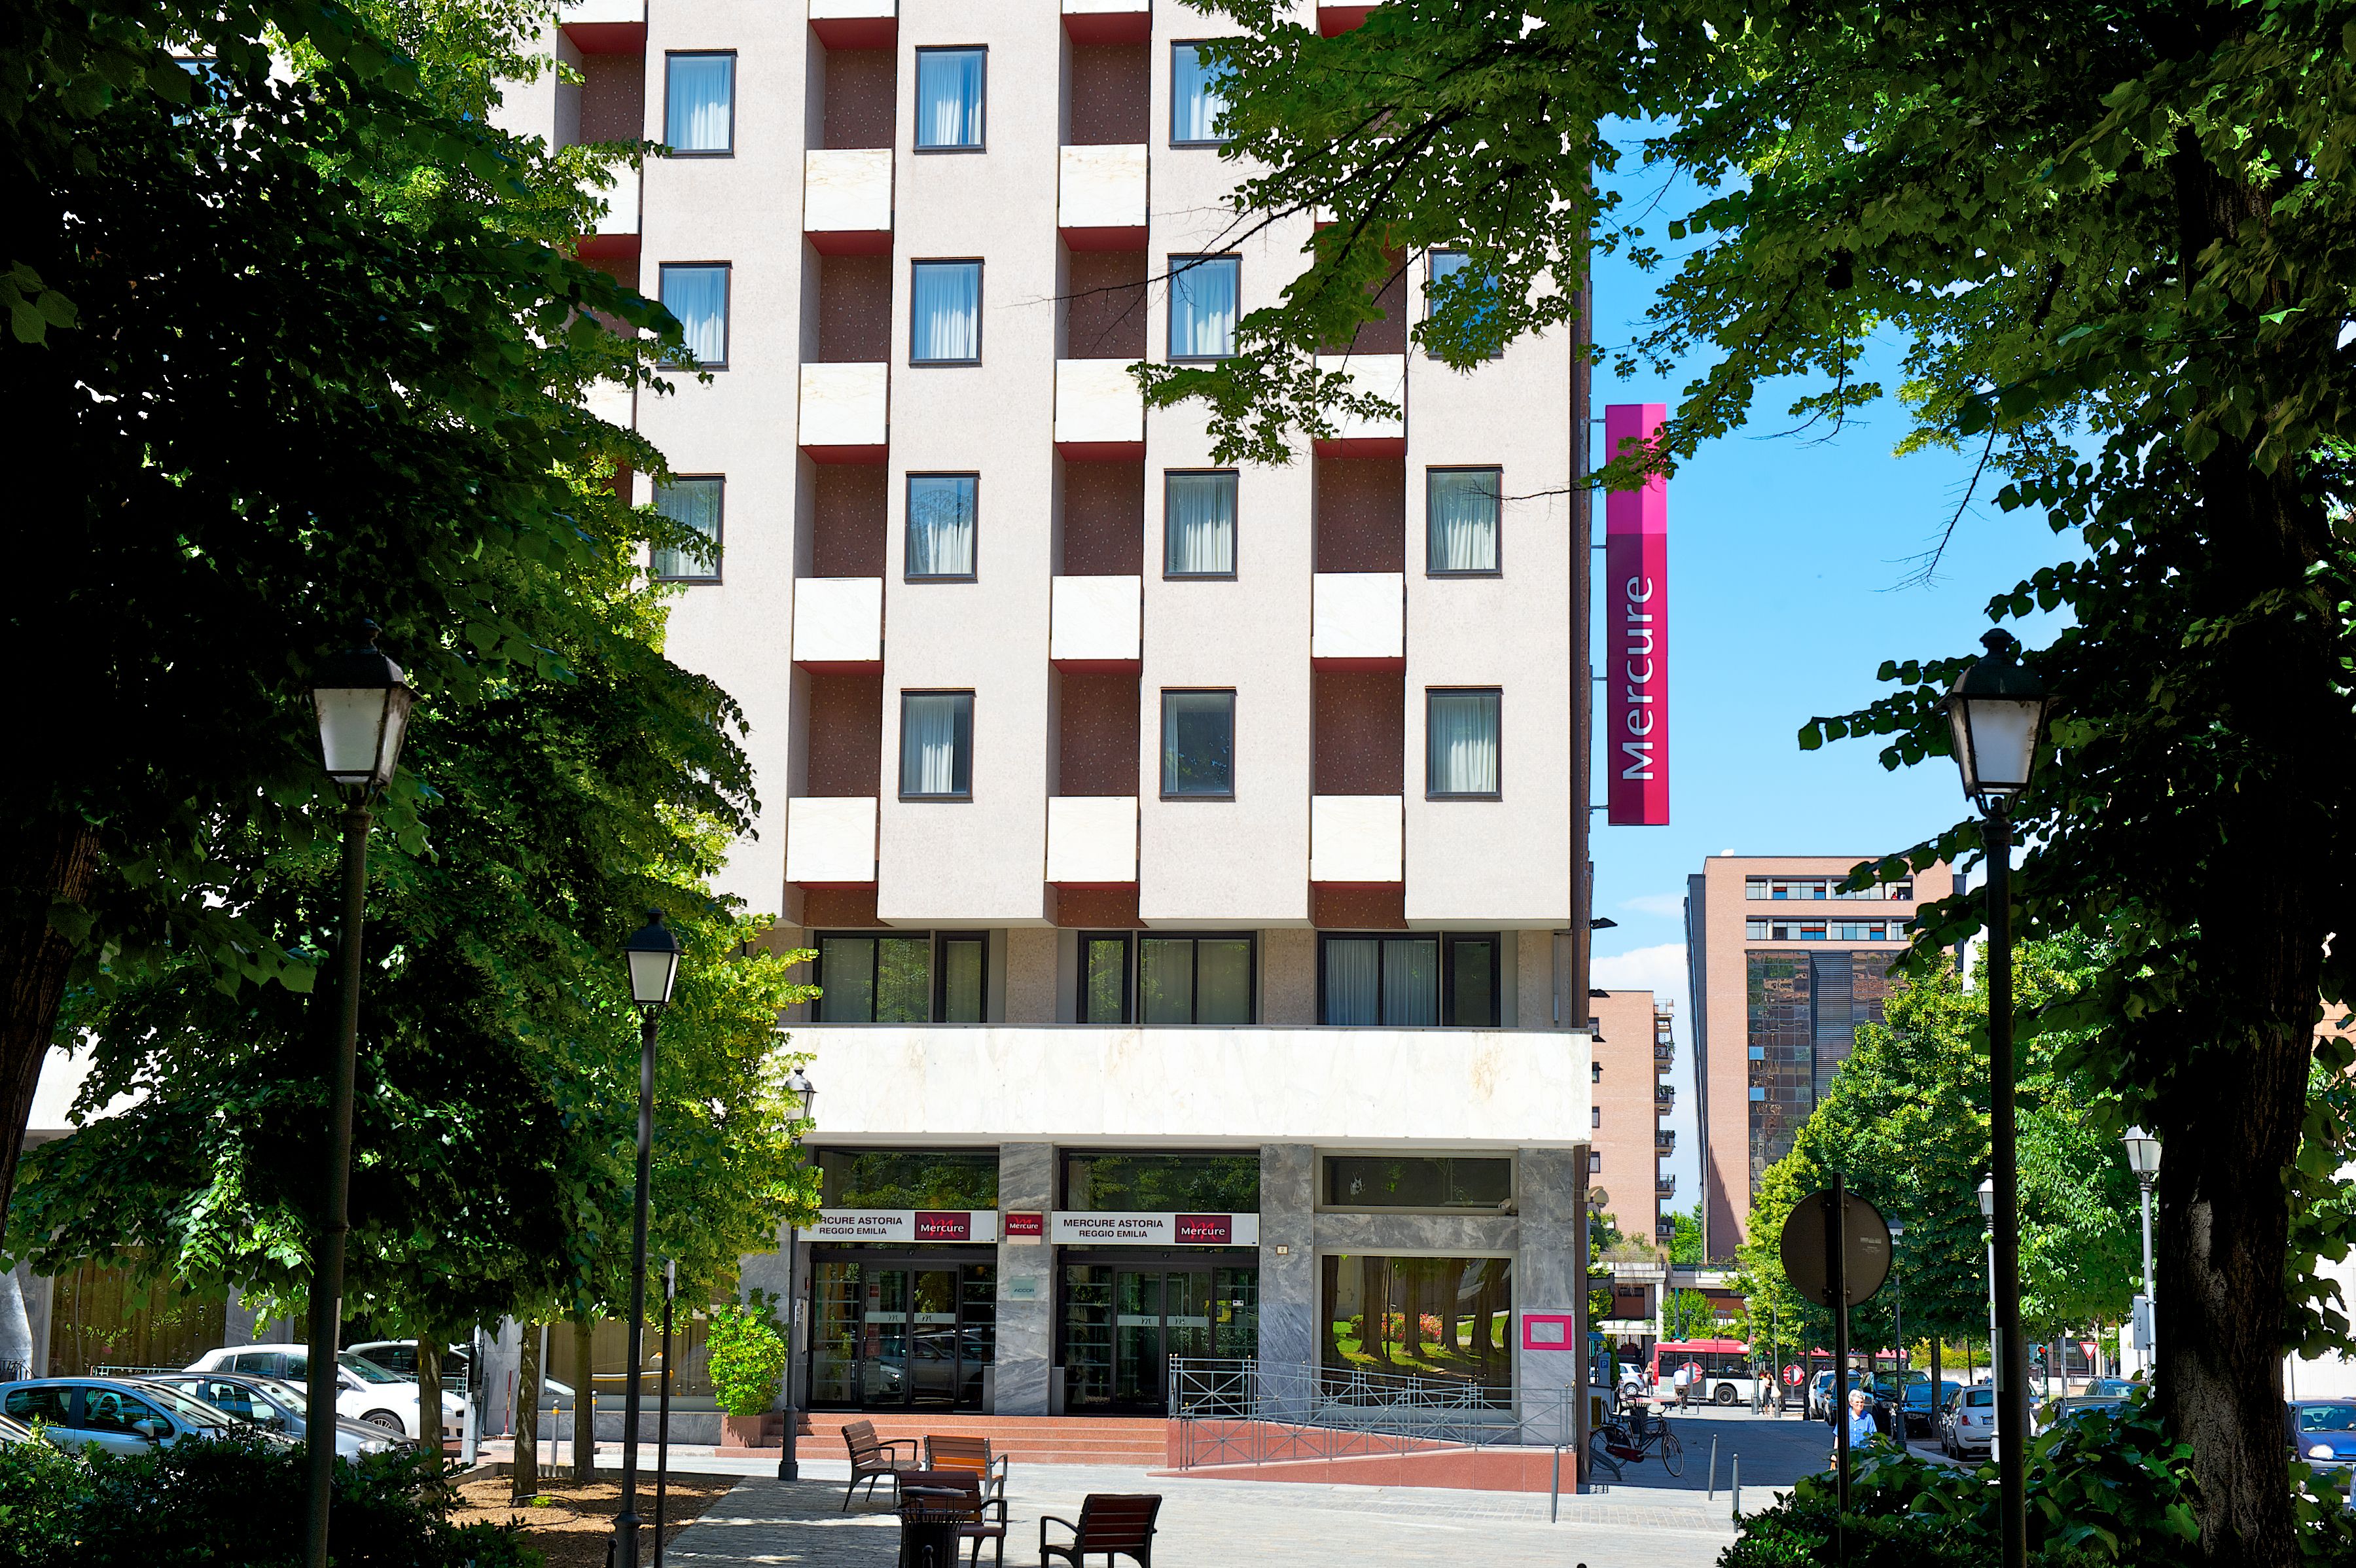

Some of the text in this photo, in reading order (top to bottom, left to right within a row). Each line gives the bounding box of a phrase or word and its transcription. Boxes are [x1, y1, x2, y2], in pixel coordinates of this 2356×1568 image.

[1622, 576, 1654, 780] Mercure
[821, 1217, 902, 1226] RCURE ASTORIA
[1063, 1219, 1164, 1228] MERCURE ASTORIA
[920, 1224, 965, 1233] Mercure
[1181, 1227, 1226, 1236] Mercure
